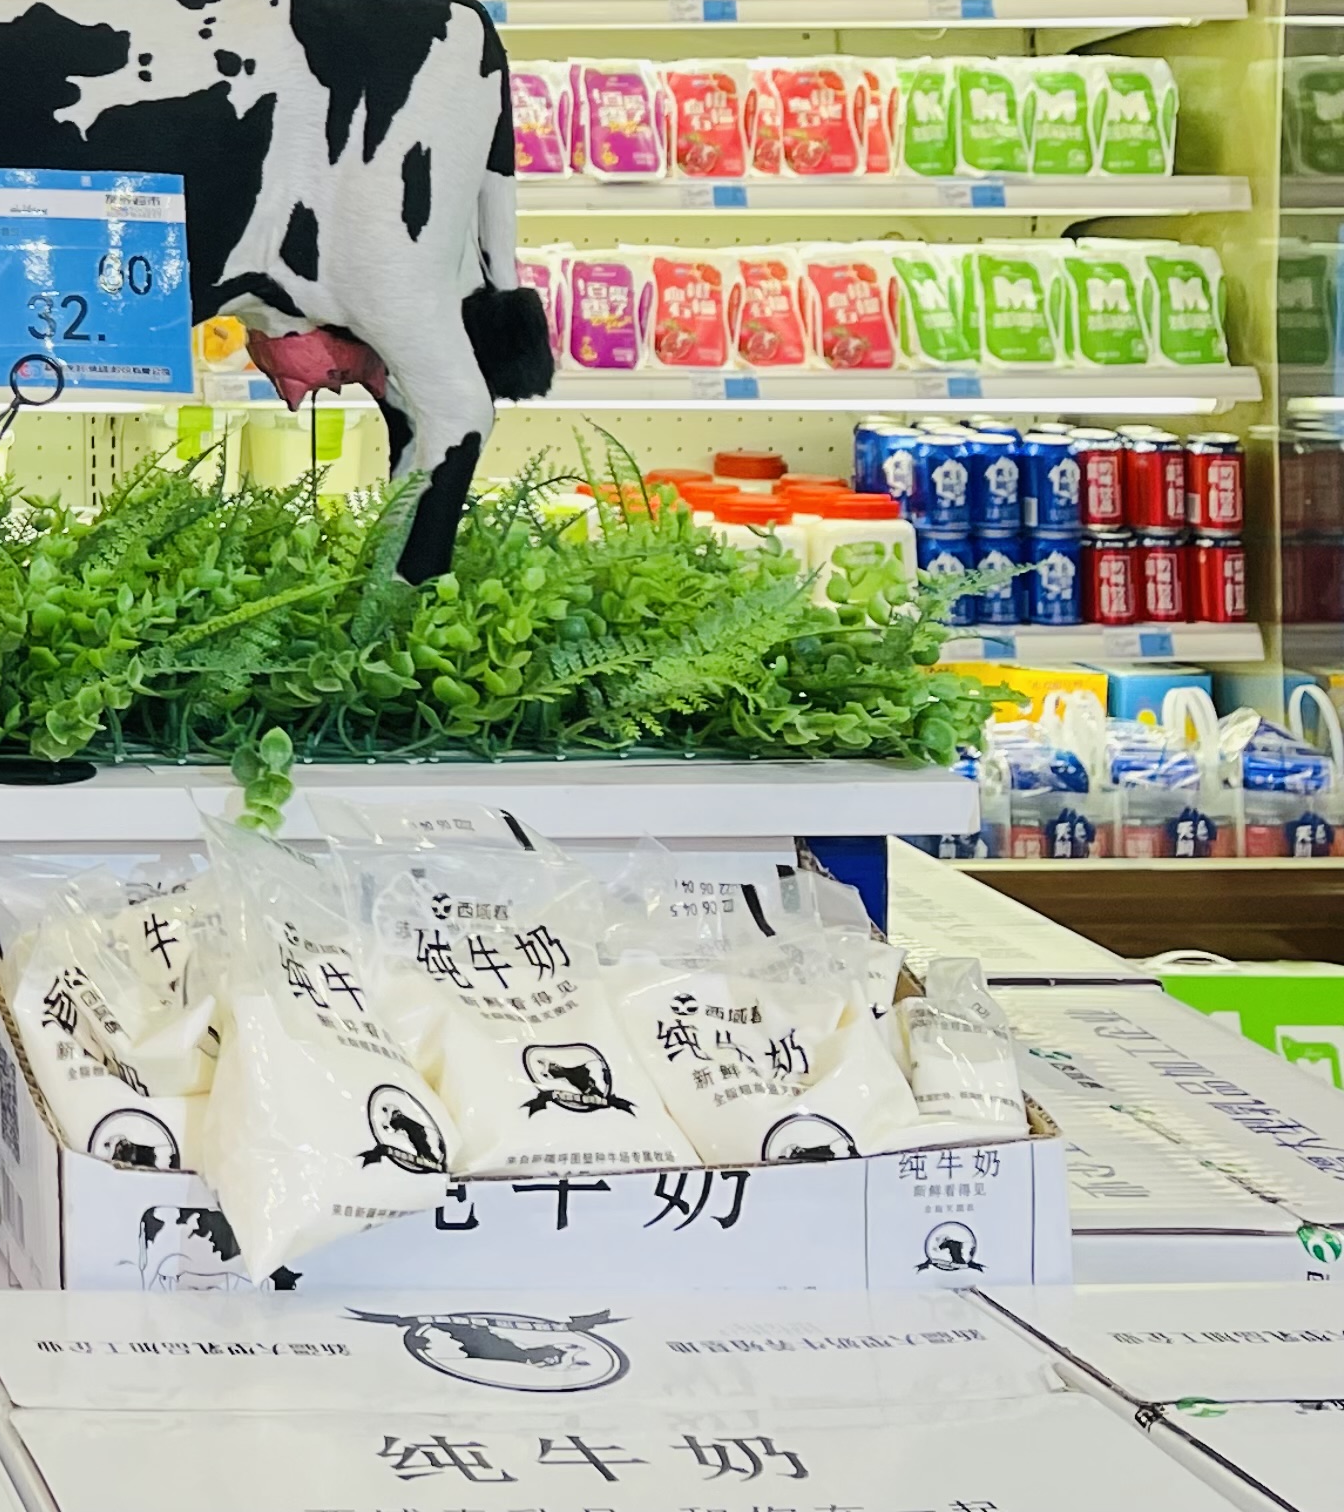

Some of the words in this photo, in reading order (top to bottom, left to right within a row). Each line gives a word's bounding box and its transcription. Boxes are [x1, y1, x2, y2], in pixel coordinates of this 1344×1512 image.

[26, 294, 107, 342] 32.
[415, 925, 572, 990] 纯牛奶
[898, 1149, 1002, 1181] 纯牛奶
[376, 1434, 812, 1484] 纯牛奶
